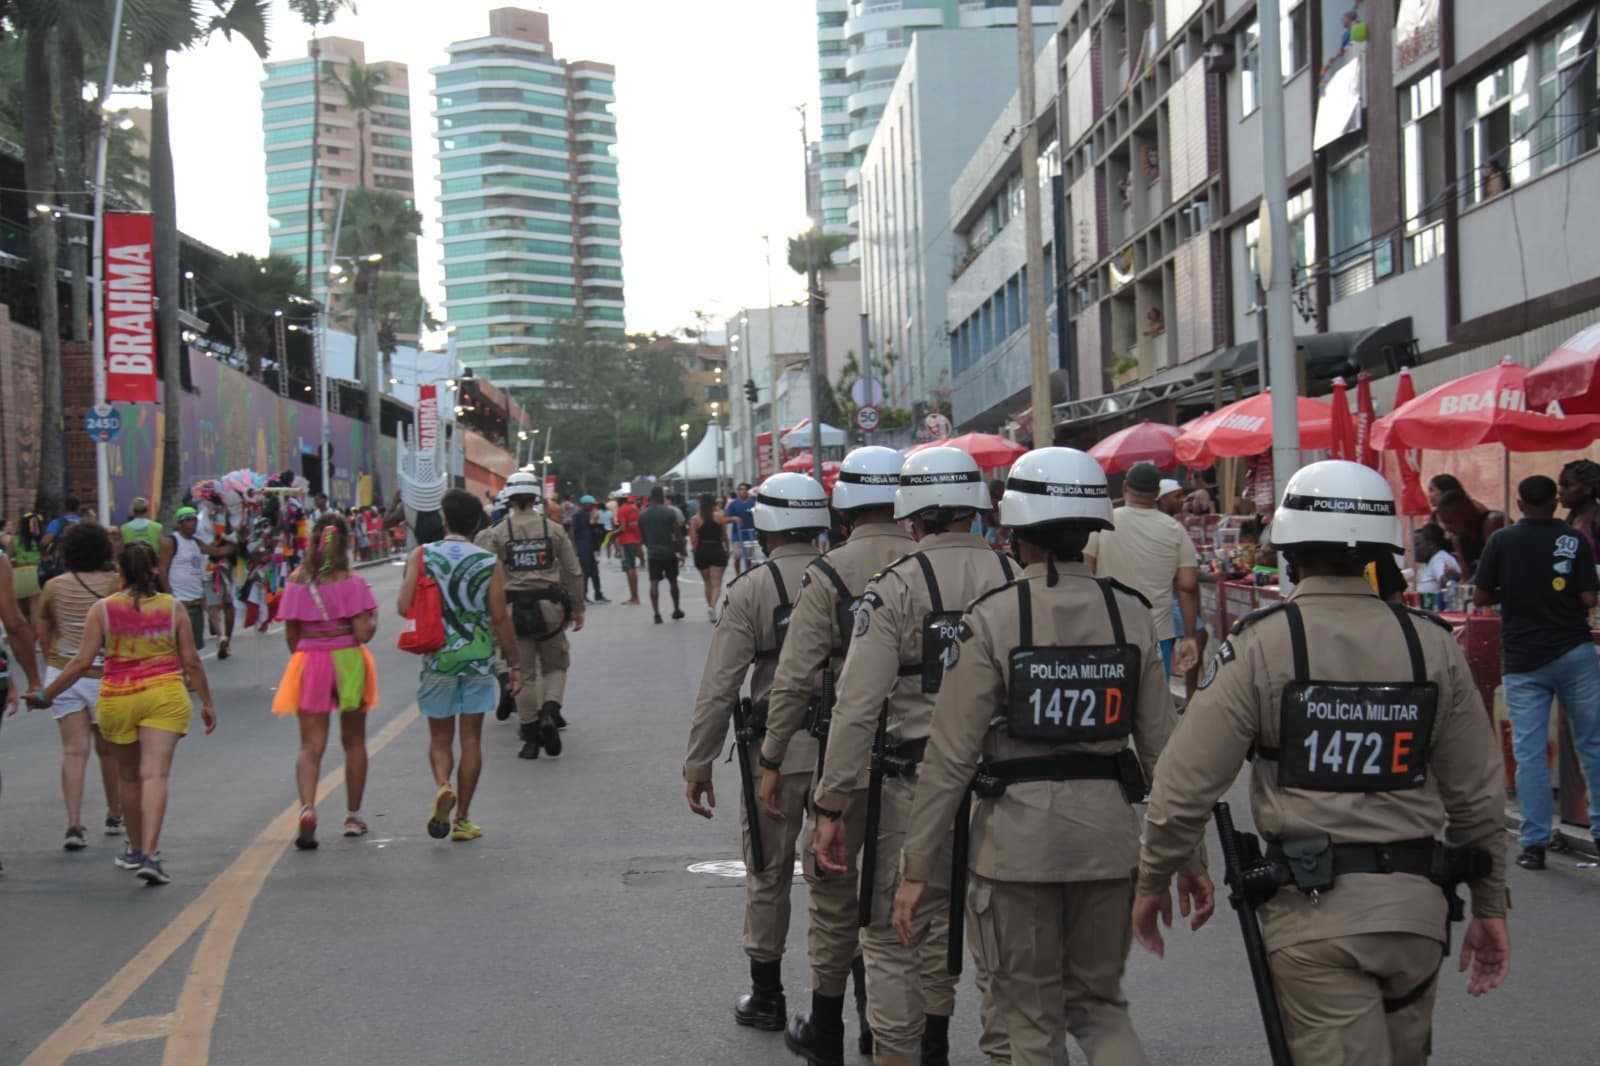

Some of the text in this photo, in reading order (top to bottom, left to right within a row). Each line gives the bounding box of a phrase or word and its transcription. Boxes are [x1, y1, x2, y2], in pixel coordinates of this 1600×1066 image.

[108, 243, 153, 375] BRAHMA
[1438, 388, 1566, 419] BRAHA
[860, 410, 877, 423] 50
[939, 474, 968, 482] MILITAR
[1046, 485, 1083, 494] POLÍCIA
[1313, 499, 1390, 513] POLÍCIA MILITAR
[1029, 661, 1125, 680] POLÍCIA MILITAR
[1029, 688, 1122, 727] 1472 D
[1306, 699, 1419, 721] POLÍCIA MILITAR
[1303, 730, 1414, 775] 1472 E
